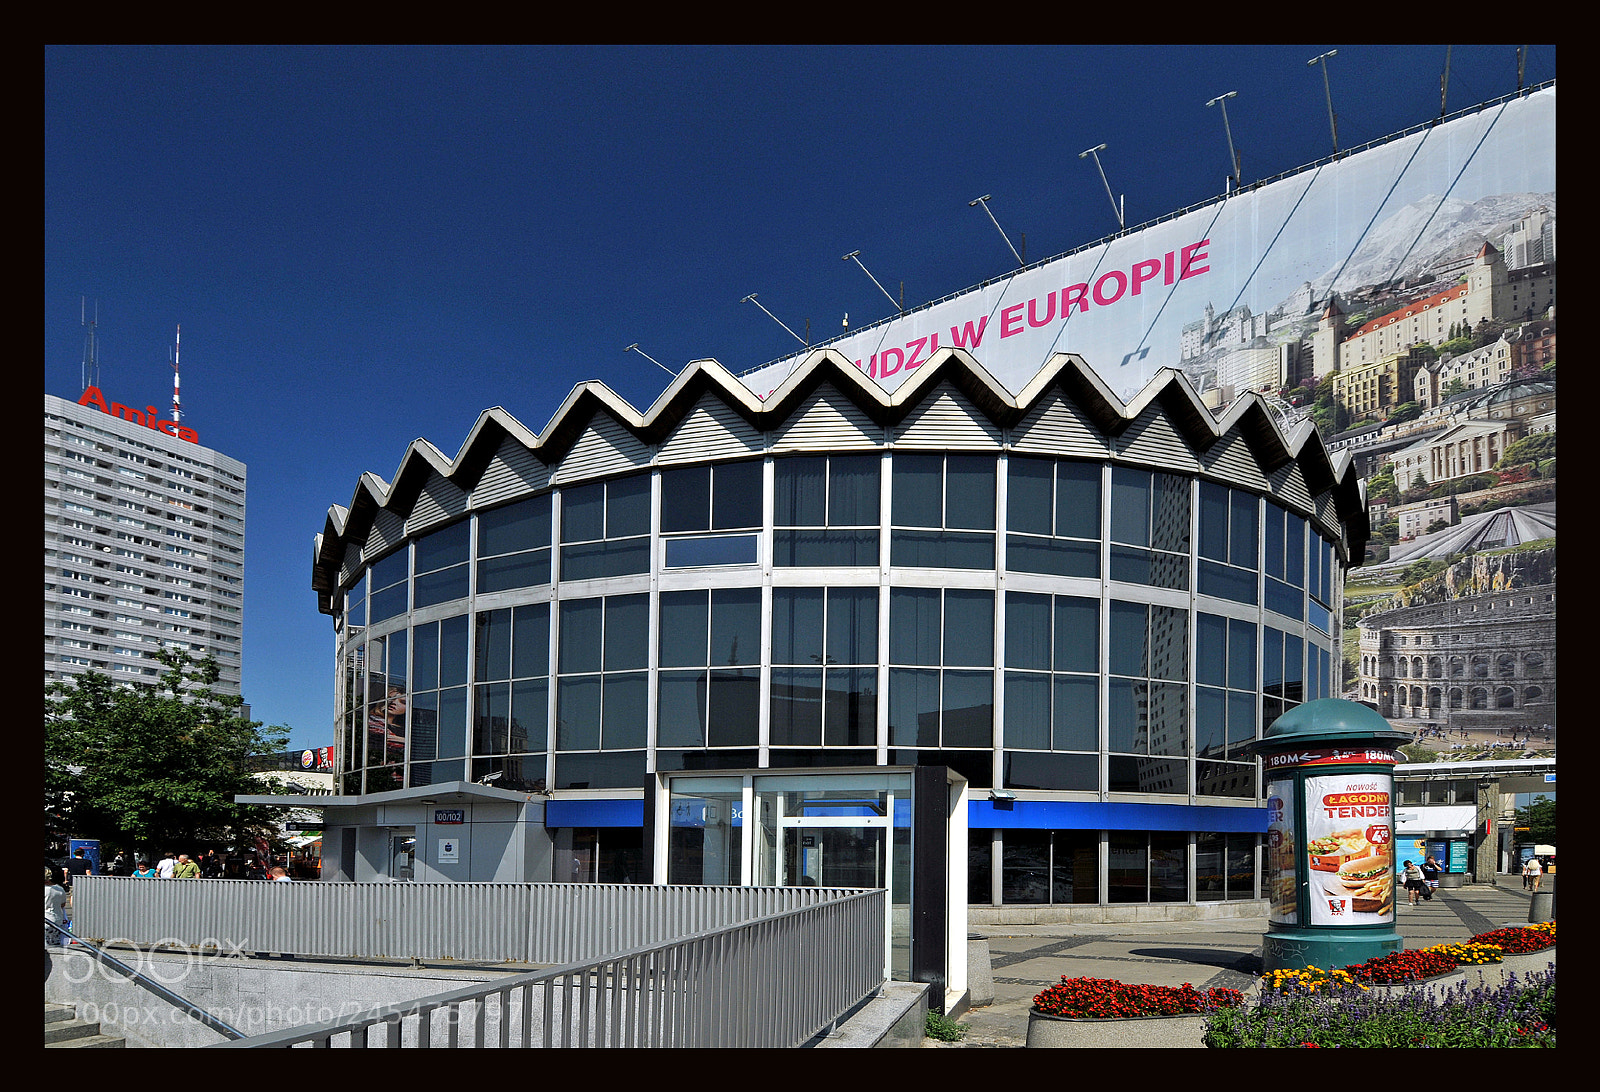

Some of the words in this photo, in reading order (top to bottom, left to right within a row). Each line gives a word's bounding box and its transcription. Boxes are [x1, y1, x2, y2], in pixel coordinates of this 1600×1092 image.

[951, 315, 988, 348] W
[1000, 238, 1211, 339] EUROPIE
[77, 385, 199, 443] Amica
[1271, 754, 1299, 766] 180M
[1346, 782, 1378, 791] NOWOŚĆ
[1329, 794, 1389, 804] ŁAGODNY
[436, 813, 461, 821] 100/102
[1324, 806, 1390, 819] TENDER
